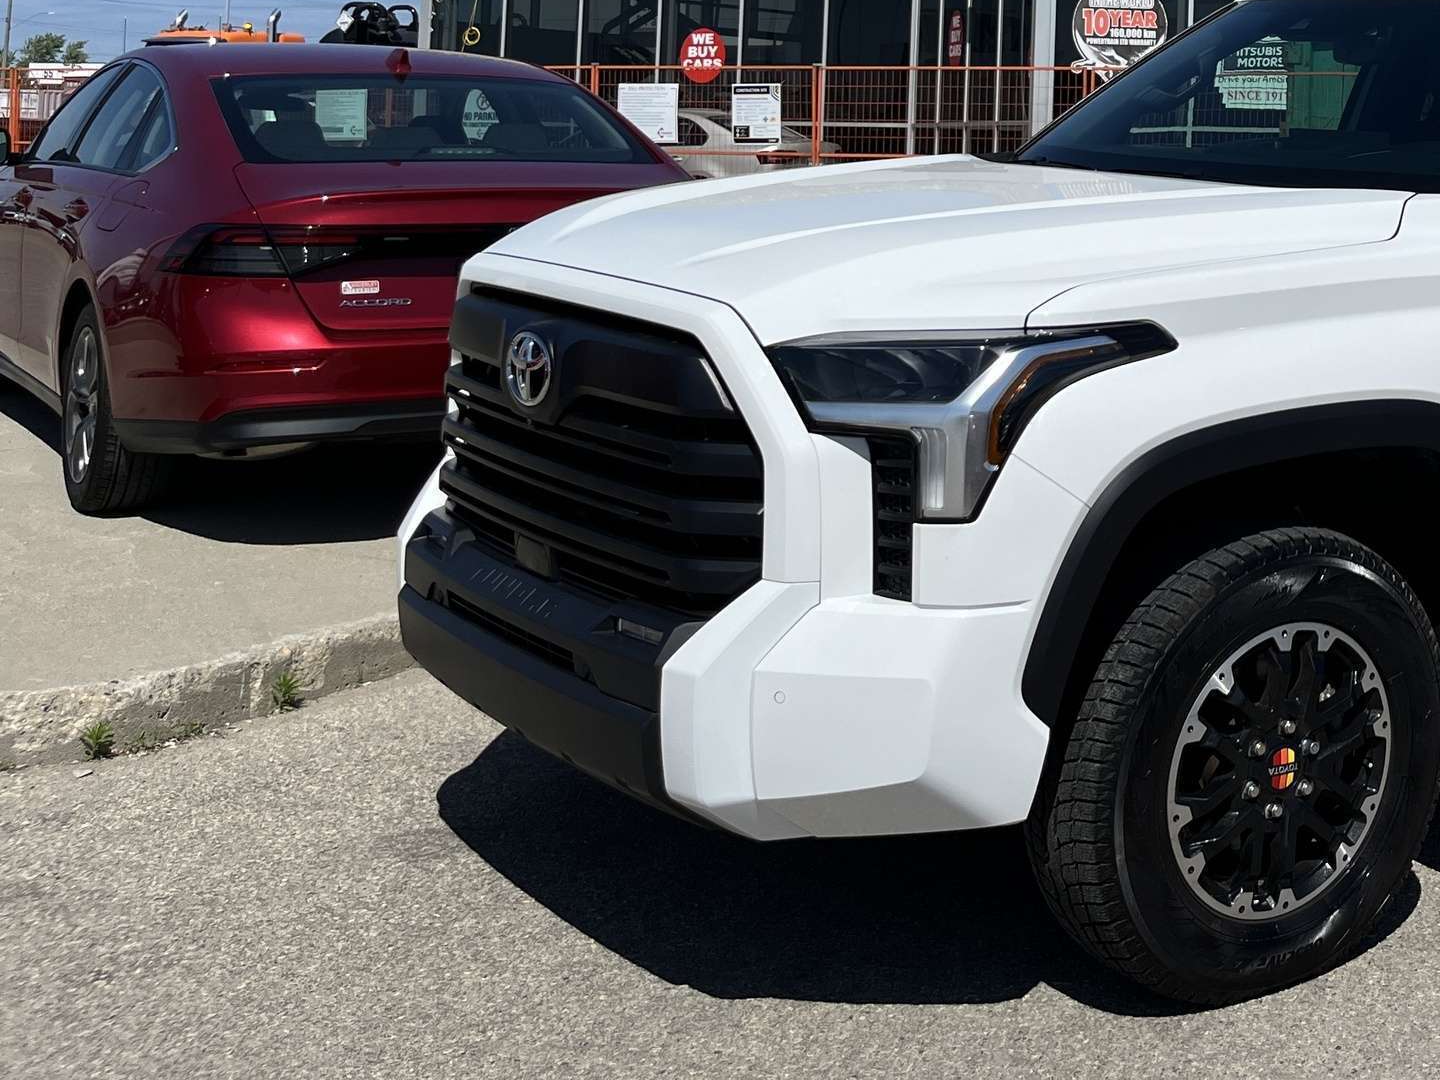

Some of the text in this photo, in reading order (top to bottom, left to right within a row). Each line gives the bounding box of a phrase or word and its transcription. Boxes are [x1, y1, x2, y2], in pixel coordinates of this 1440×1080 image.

[1083, 8, 1157, 36] 10 YEAR
[691, 33, 714, 45] WE
[688, 46, 718, 58] BUY
[683, 58, 722, 70] CARS
[1237, 57, 1285, 68] MOTORS
[1242, 76, 1261, 85] your
[1228, 90, 1261, 101] SINCE
[339, 298, 413, 308] ACCORD
[1268, 762, 1299, 776] TOYOTA
